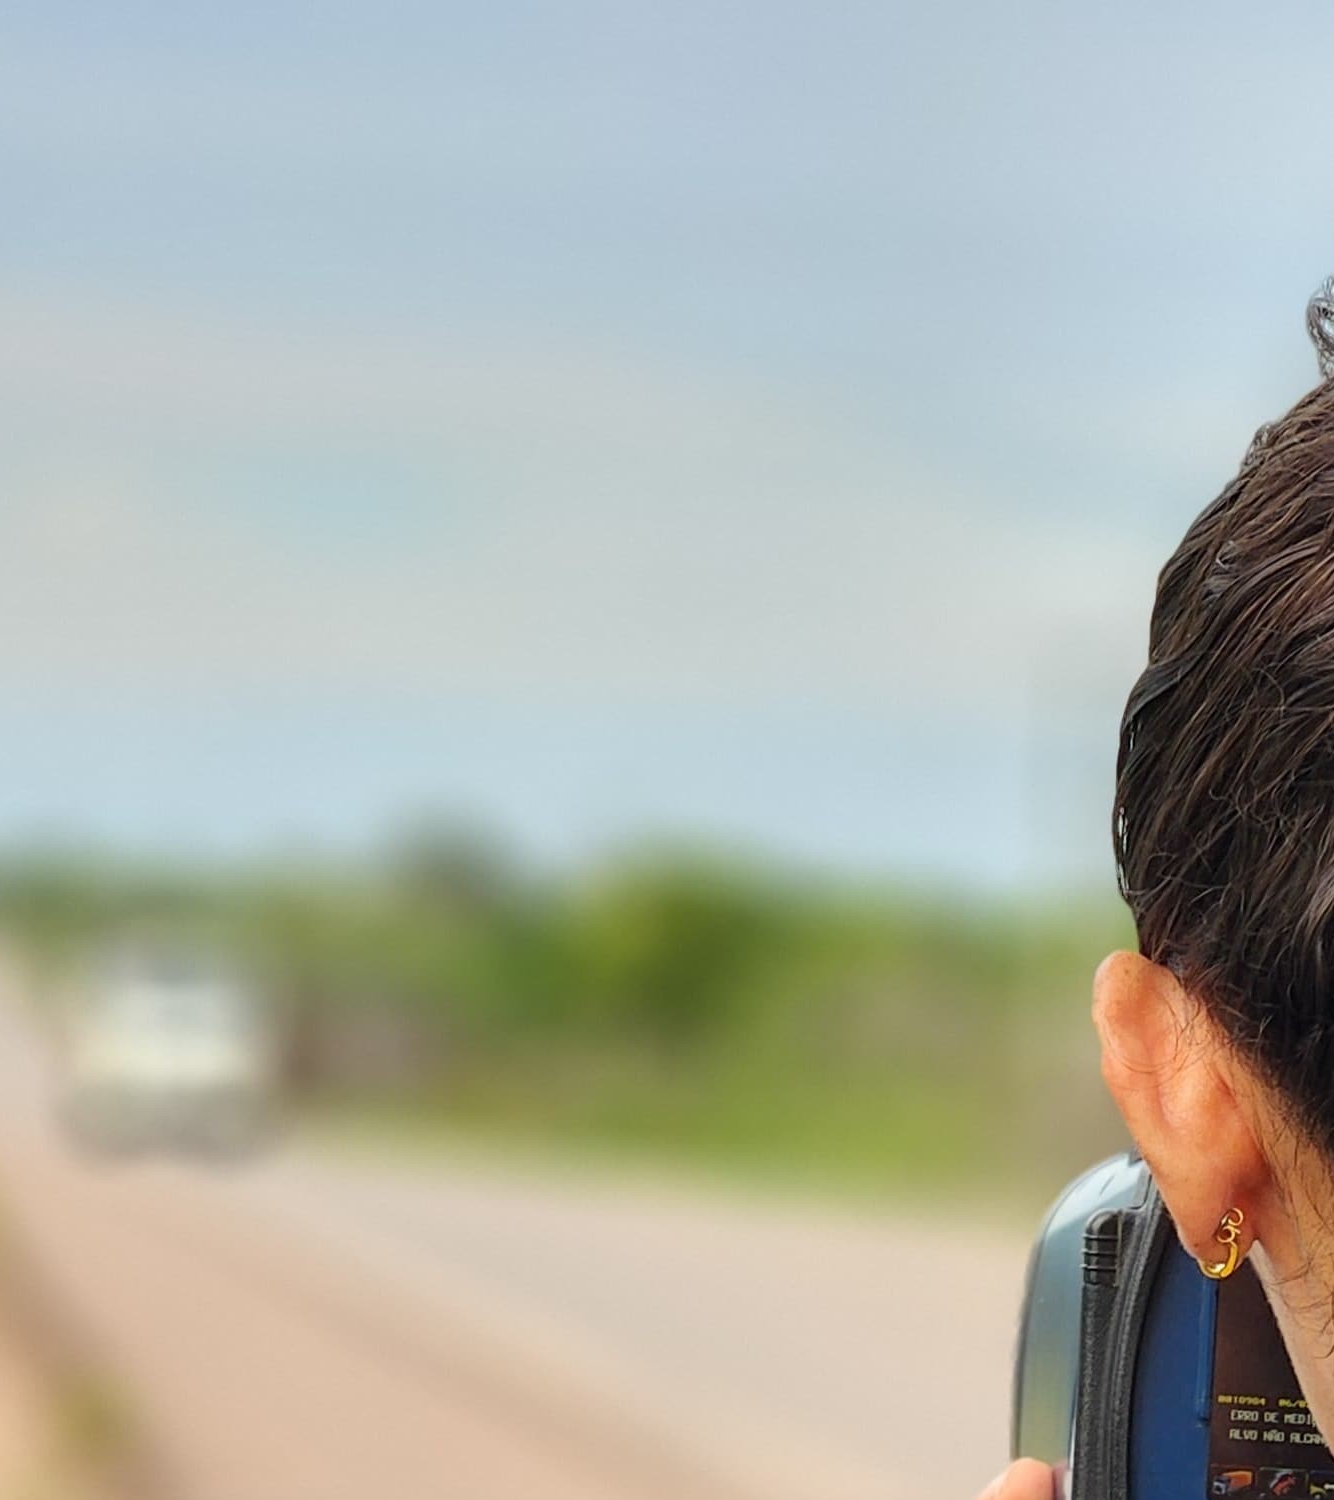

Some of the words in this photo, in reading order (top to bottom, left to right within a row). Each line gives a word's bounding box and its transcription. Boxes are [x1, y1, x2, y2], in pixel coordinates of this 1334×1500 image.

[1230, 1410, 1259, 1422] ERRO
[1264, 1411, 1280, 1423] DE
[1284, 1413, 1316, 1428] MEDI
[1229, 1429, 1259, 1441] ALVO
[1263, 1429, 1285, 1442] NÃO
